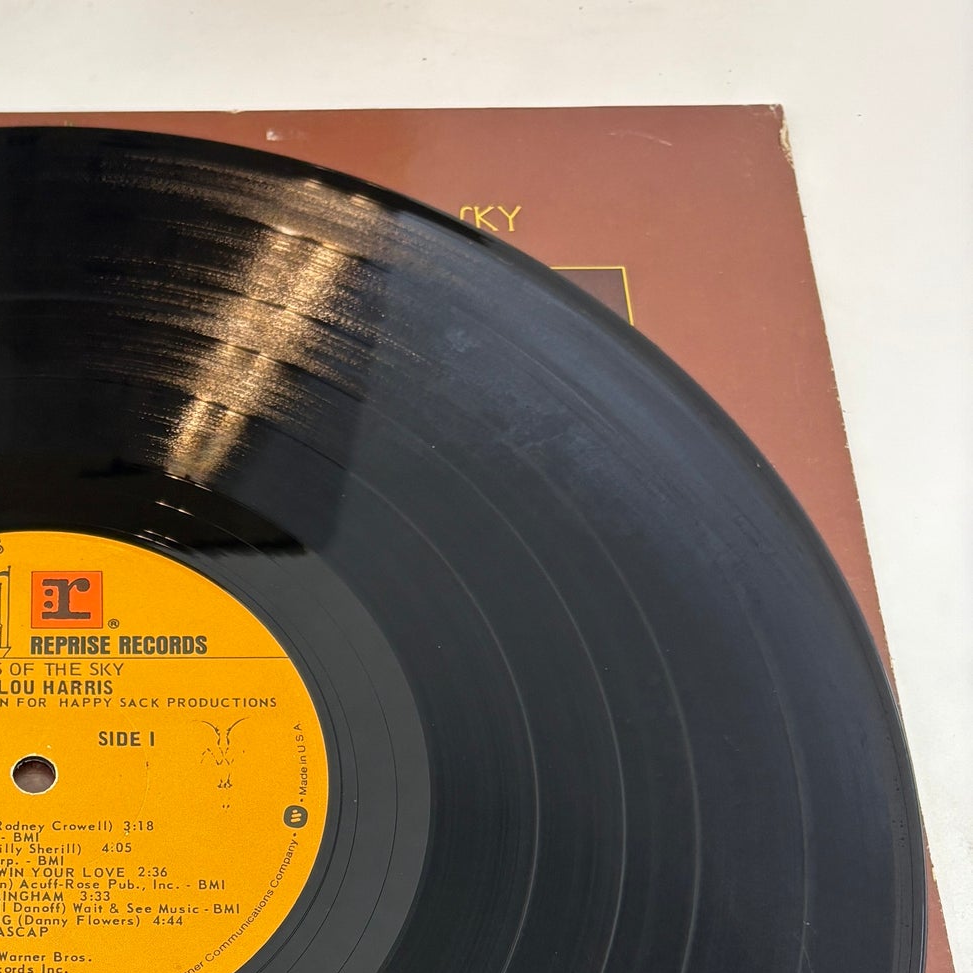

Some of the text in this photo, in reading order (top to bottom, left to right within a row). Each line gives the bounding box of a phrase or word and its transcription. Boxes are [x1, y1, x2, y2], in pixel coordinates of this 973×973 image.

[30, 635, 208, 655] REPRISE RECORDS
[9, 662, 34, 676] OF
[44, 662, 82, 676] THE
[89, 662, 124, 677] SKY
[43, 680, 114, 695] HARRIS
[17, 697, 47, 708] FOR
[59, 697, 112, 708] HAPPY
[120, 697, 160, 708] SACK
[167, 697, 277, 708] PRODUCTIONS
[98, 731, 141, 747] SIDE
[299, 755, 307, 765] in
[299, 766, 308, 796] Made
[52, 820, 113, 832] Crowell)
[123, 820, 154, 831] 3:18
[13, 832, 39, 842] BMI
[29, 844, 82, 855] Sherill)
[101, 842, 132, 853] 4:05
[38, 855, 64, 866] BMI
[31, 867, 74, 878] YOUR
[82, 867, 125, 878] LOVE
[138, 866, 168, 877] 2:36
[19, 879, 100, 890] Acuff-Rose
[108, 879, 146, 891] Pub.,
[153, 879, 180, 890] Inc.
[198, 879, 225, 890] BMI
[80, 891, 111, 902] 3:33
[205, 889, 274, 962] Communications
[270, 839, 299, 889] Company
[13, 902, 66, 914] Danoff)
[73, 903, 103, 914] Wait
[109, 903, 119, 914] &
[127, 903, 152, 914] See
[158, 903, 200, 914] Music
[213, 903, 240, 914] BMI
[18, 914, 68, 927] (Danny
[76, 915, 140, 927] Flowers)
[152, 915, 183, 926] 4:44
[53, 951, 92, 962] Bros.
